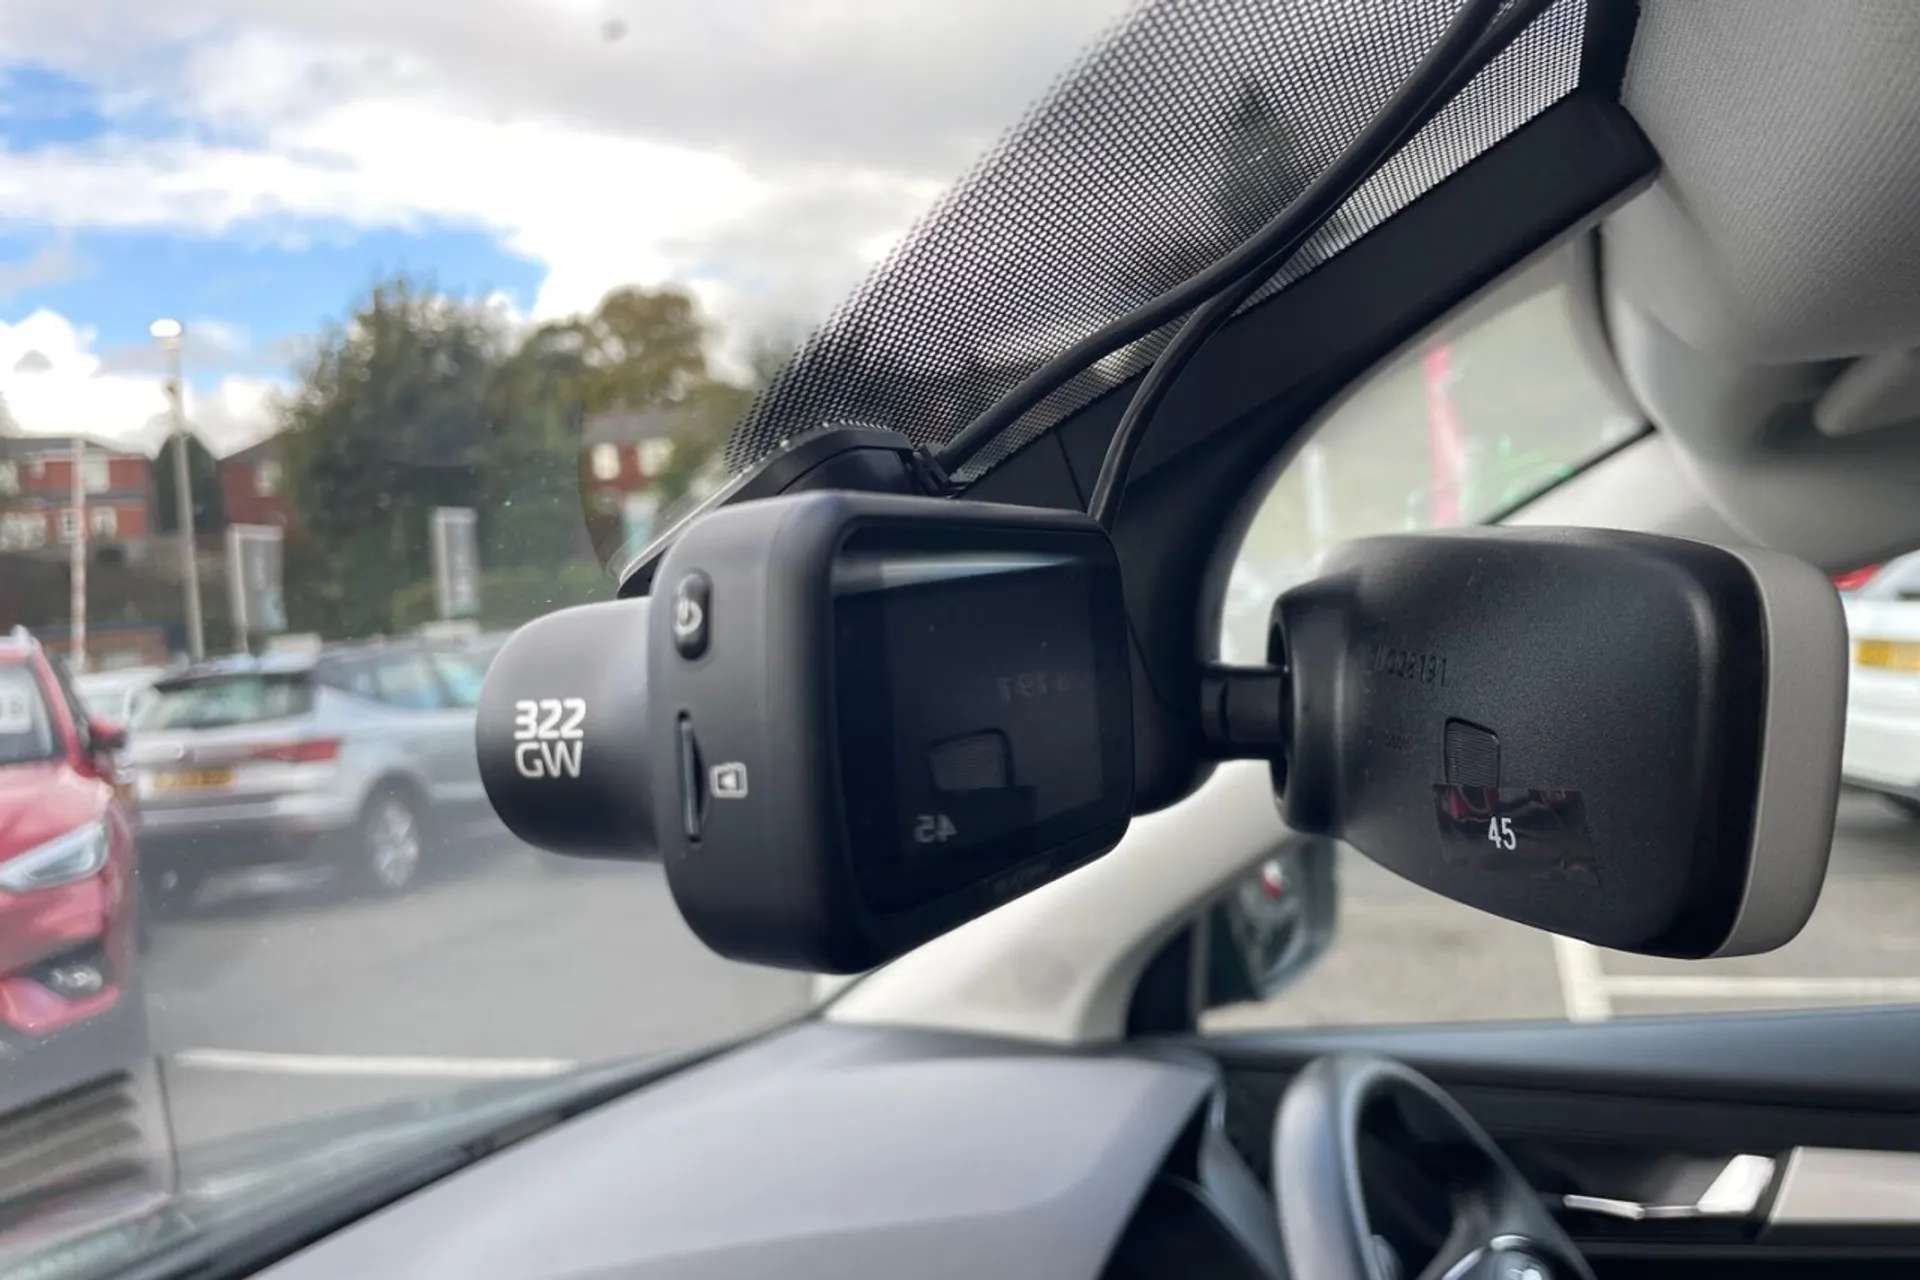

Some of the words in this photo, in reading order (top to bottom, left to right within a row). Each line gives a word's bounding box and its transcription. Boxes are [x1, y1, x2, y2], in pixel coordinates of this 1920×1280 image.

[514, 698, 586, 739] 322
[515, 740, 583, 777] GW
[1488, 816, 1516, 850] 45
